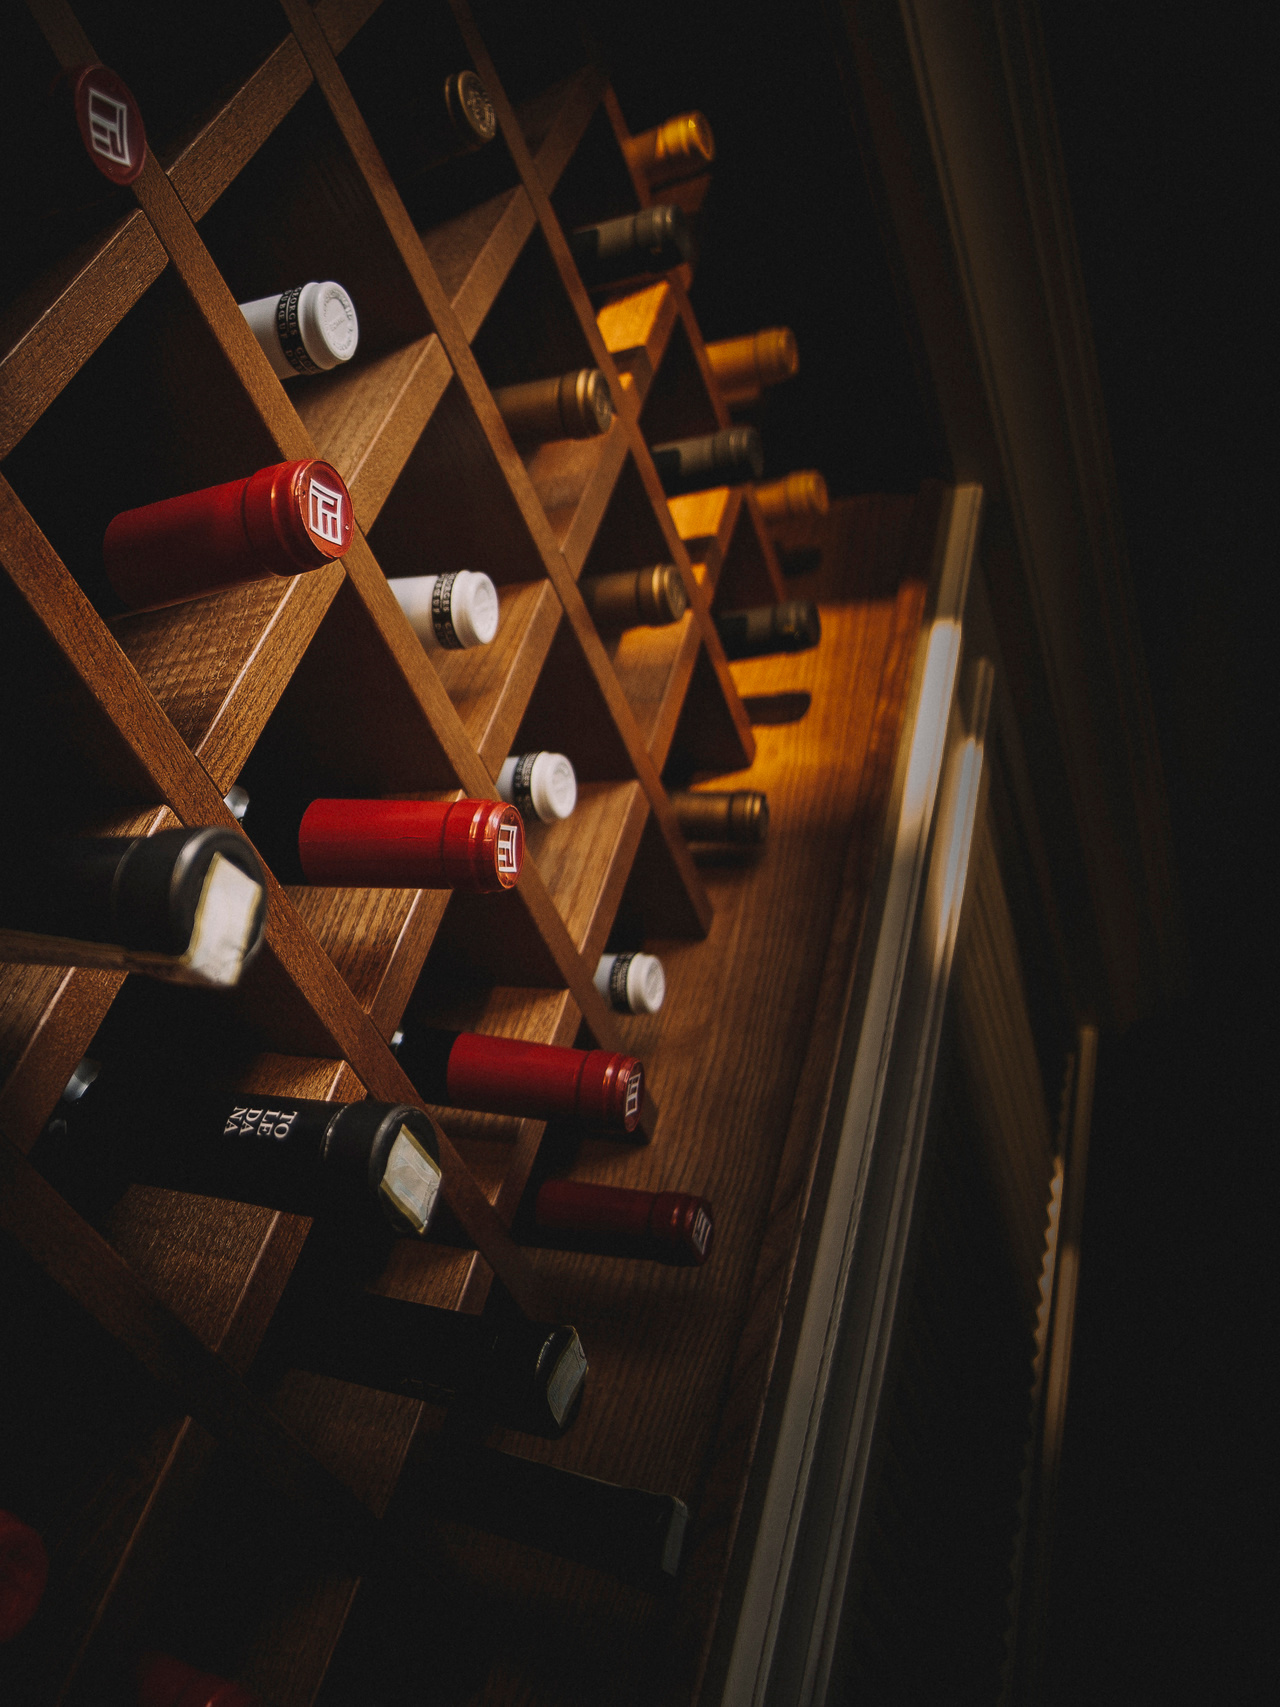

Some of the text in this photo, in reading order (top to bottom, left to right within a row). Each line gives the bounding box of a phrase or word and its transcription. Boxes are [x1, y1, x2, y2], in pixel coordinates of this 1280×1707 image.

[223, 1106, 248, 1135] NA
[239, 1108, 263, 1136] DA
[257, 1109, 281, 1136] LE
[274, 1111, 298, 1139] TO
